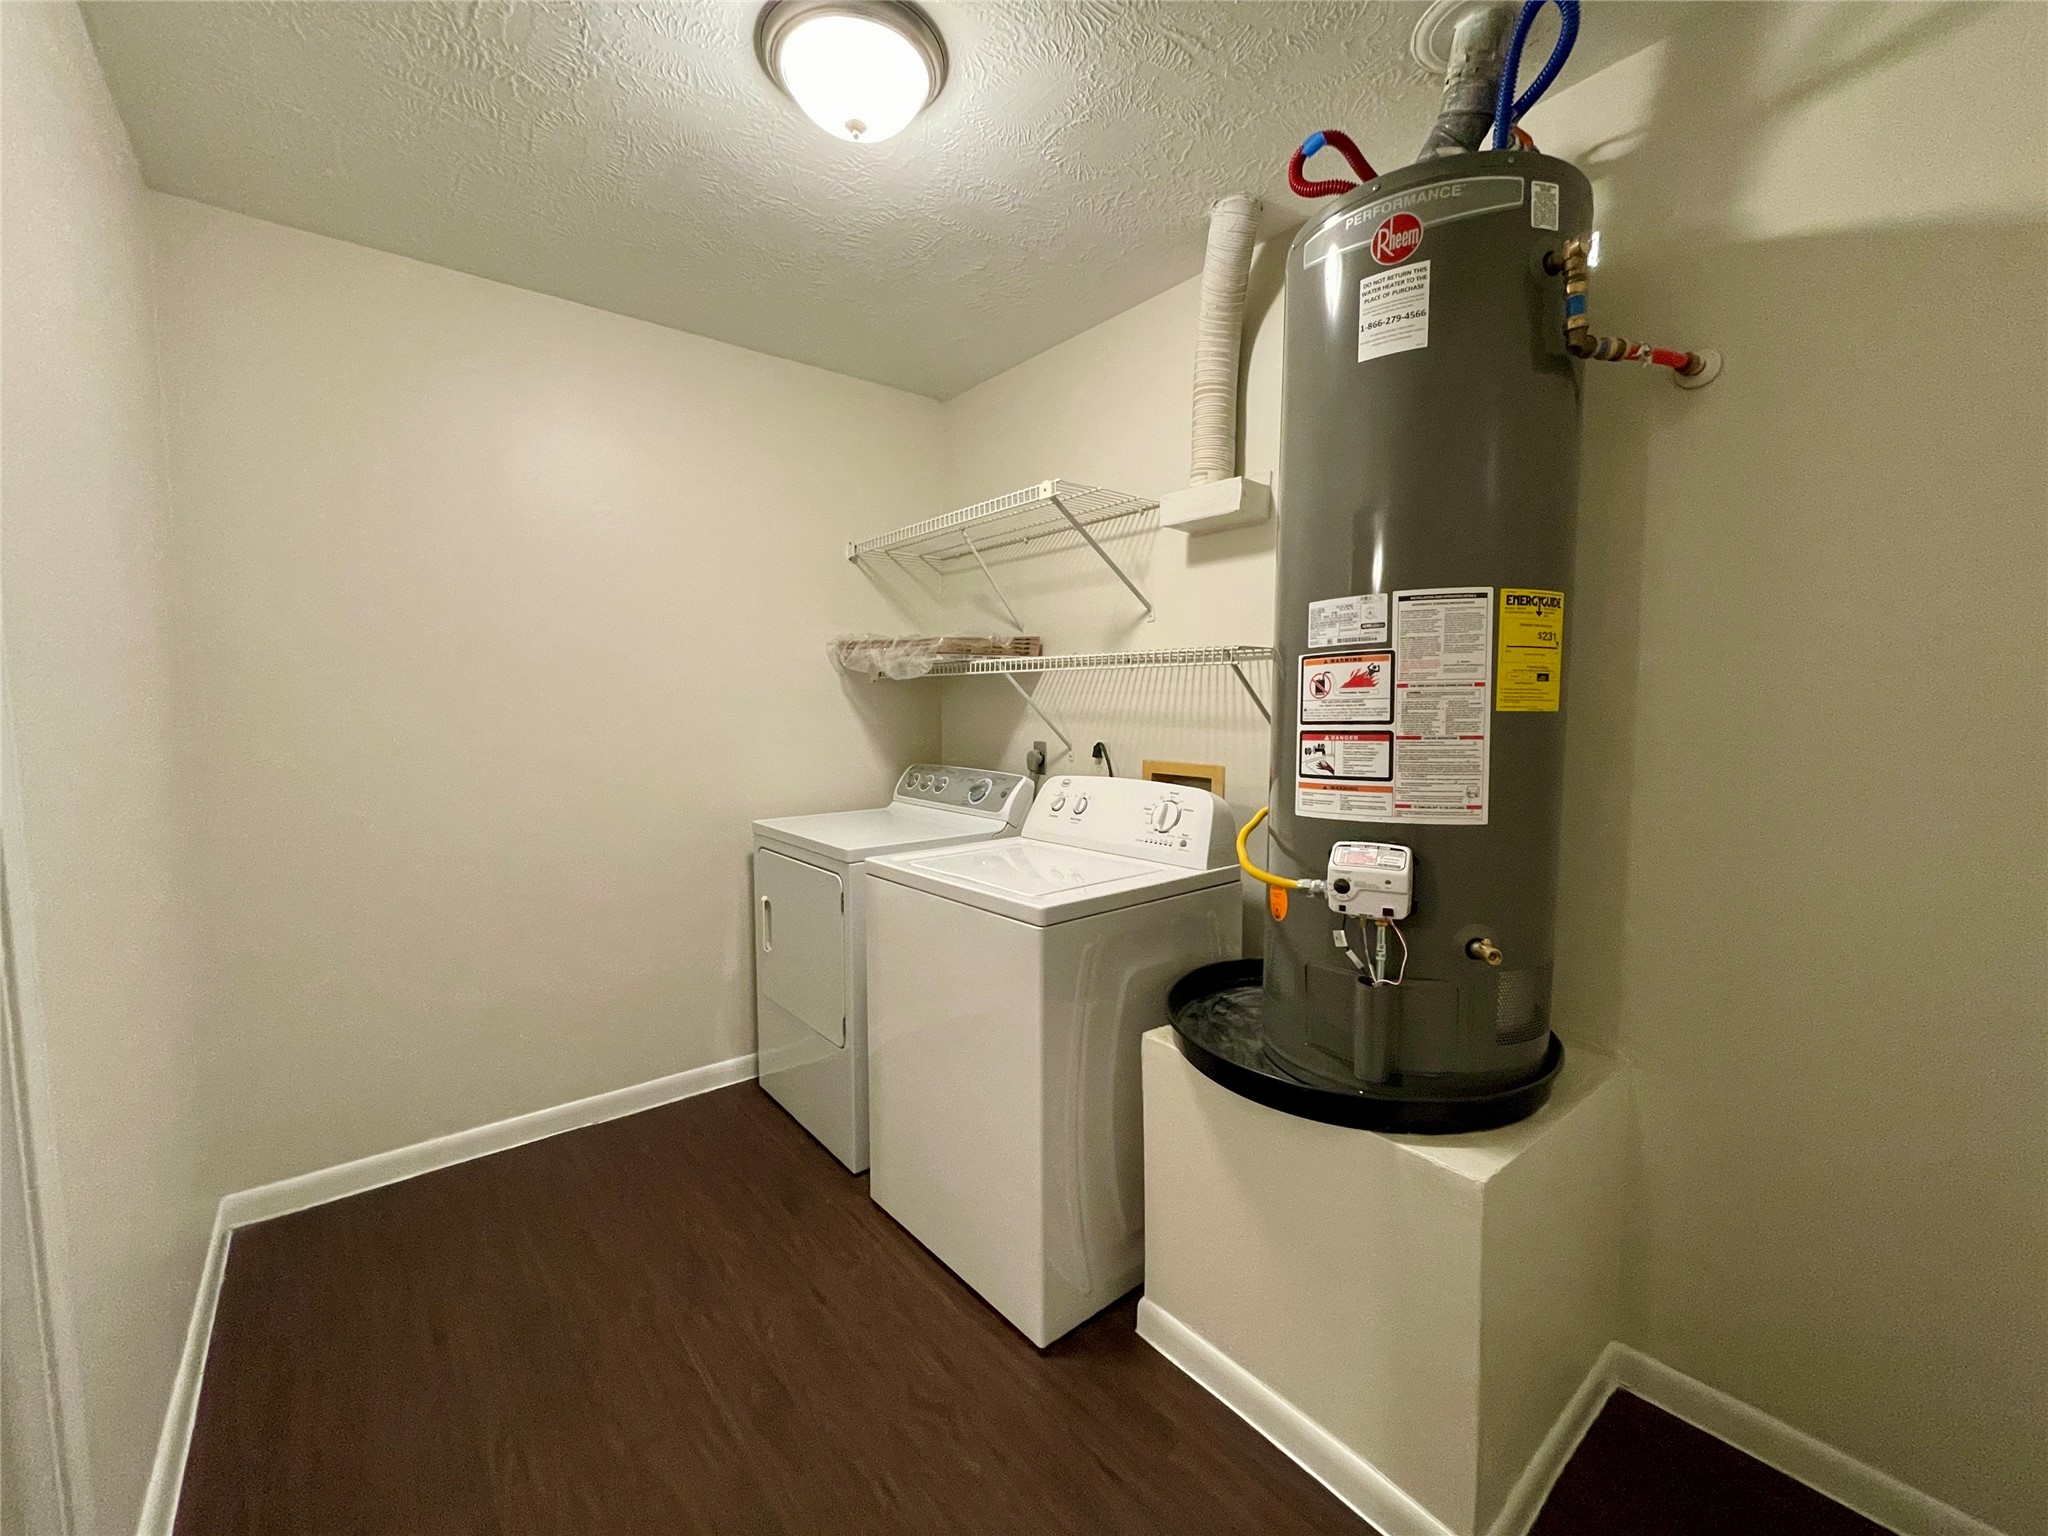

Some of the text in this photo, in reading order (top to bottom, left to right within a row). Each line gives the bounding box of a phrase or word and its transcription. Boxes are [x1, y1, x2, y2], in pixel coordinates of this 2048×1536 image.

[1345, 185, 1462, 230] PERFORMANCE
[1375, 217, 1420, 260] Rheem
[1361, 286, 1382, 298] WATER
[1382, 279, 1405, 290] HEATER
[1362, 266, 1428, 290] DO NOT RETURN THIS
[1363, 283, 1425, 304] PLACE OF PURCHASE
[1360, 309, 1427, 333] 1-866-279-4566
[1330, 656, 1363, 664] WARNING
